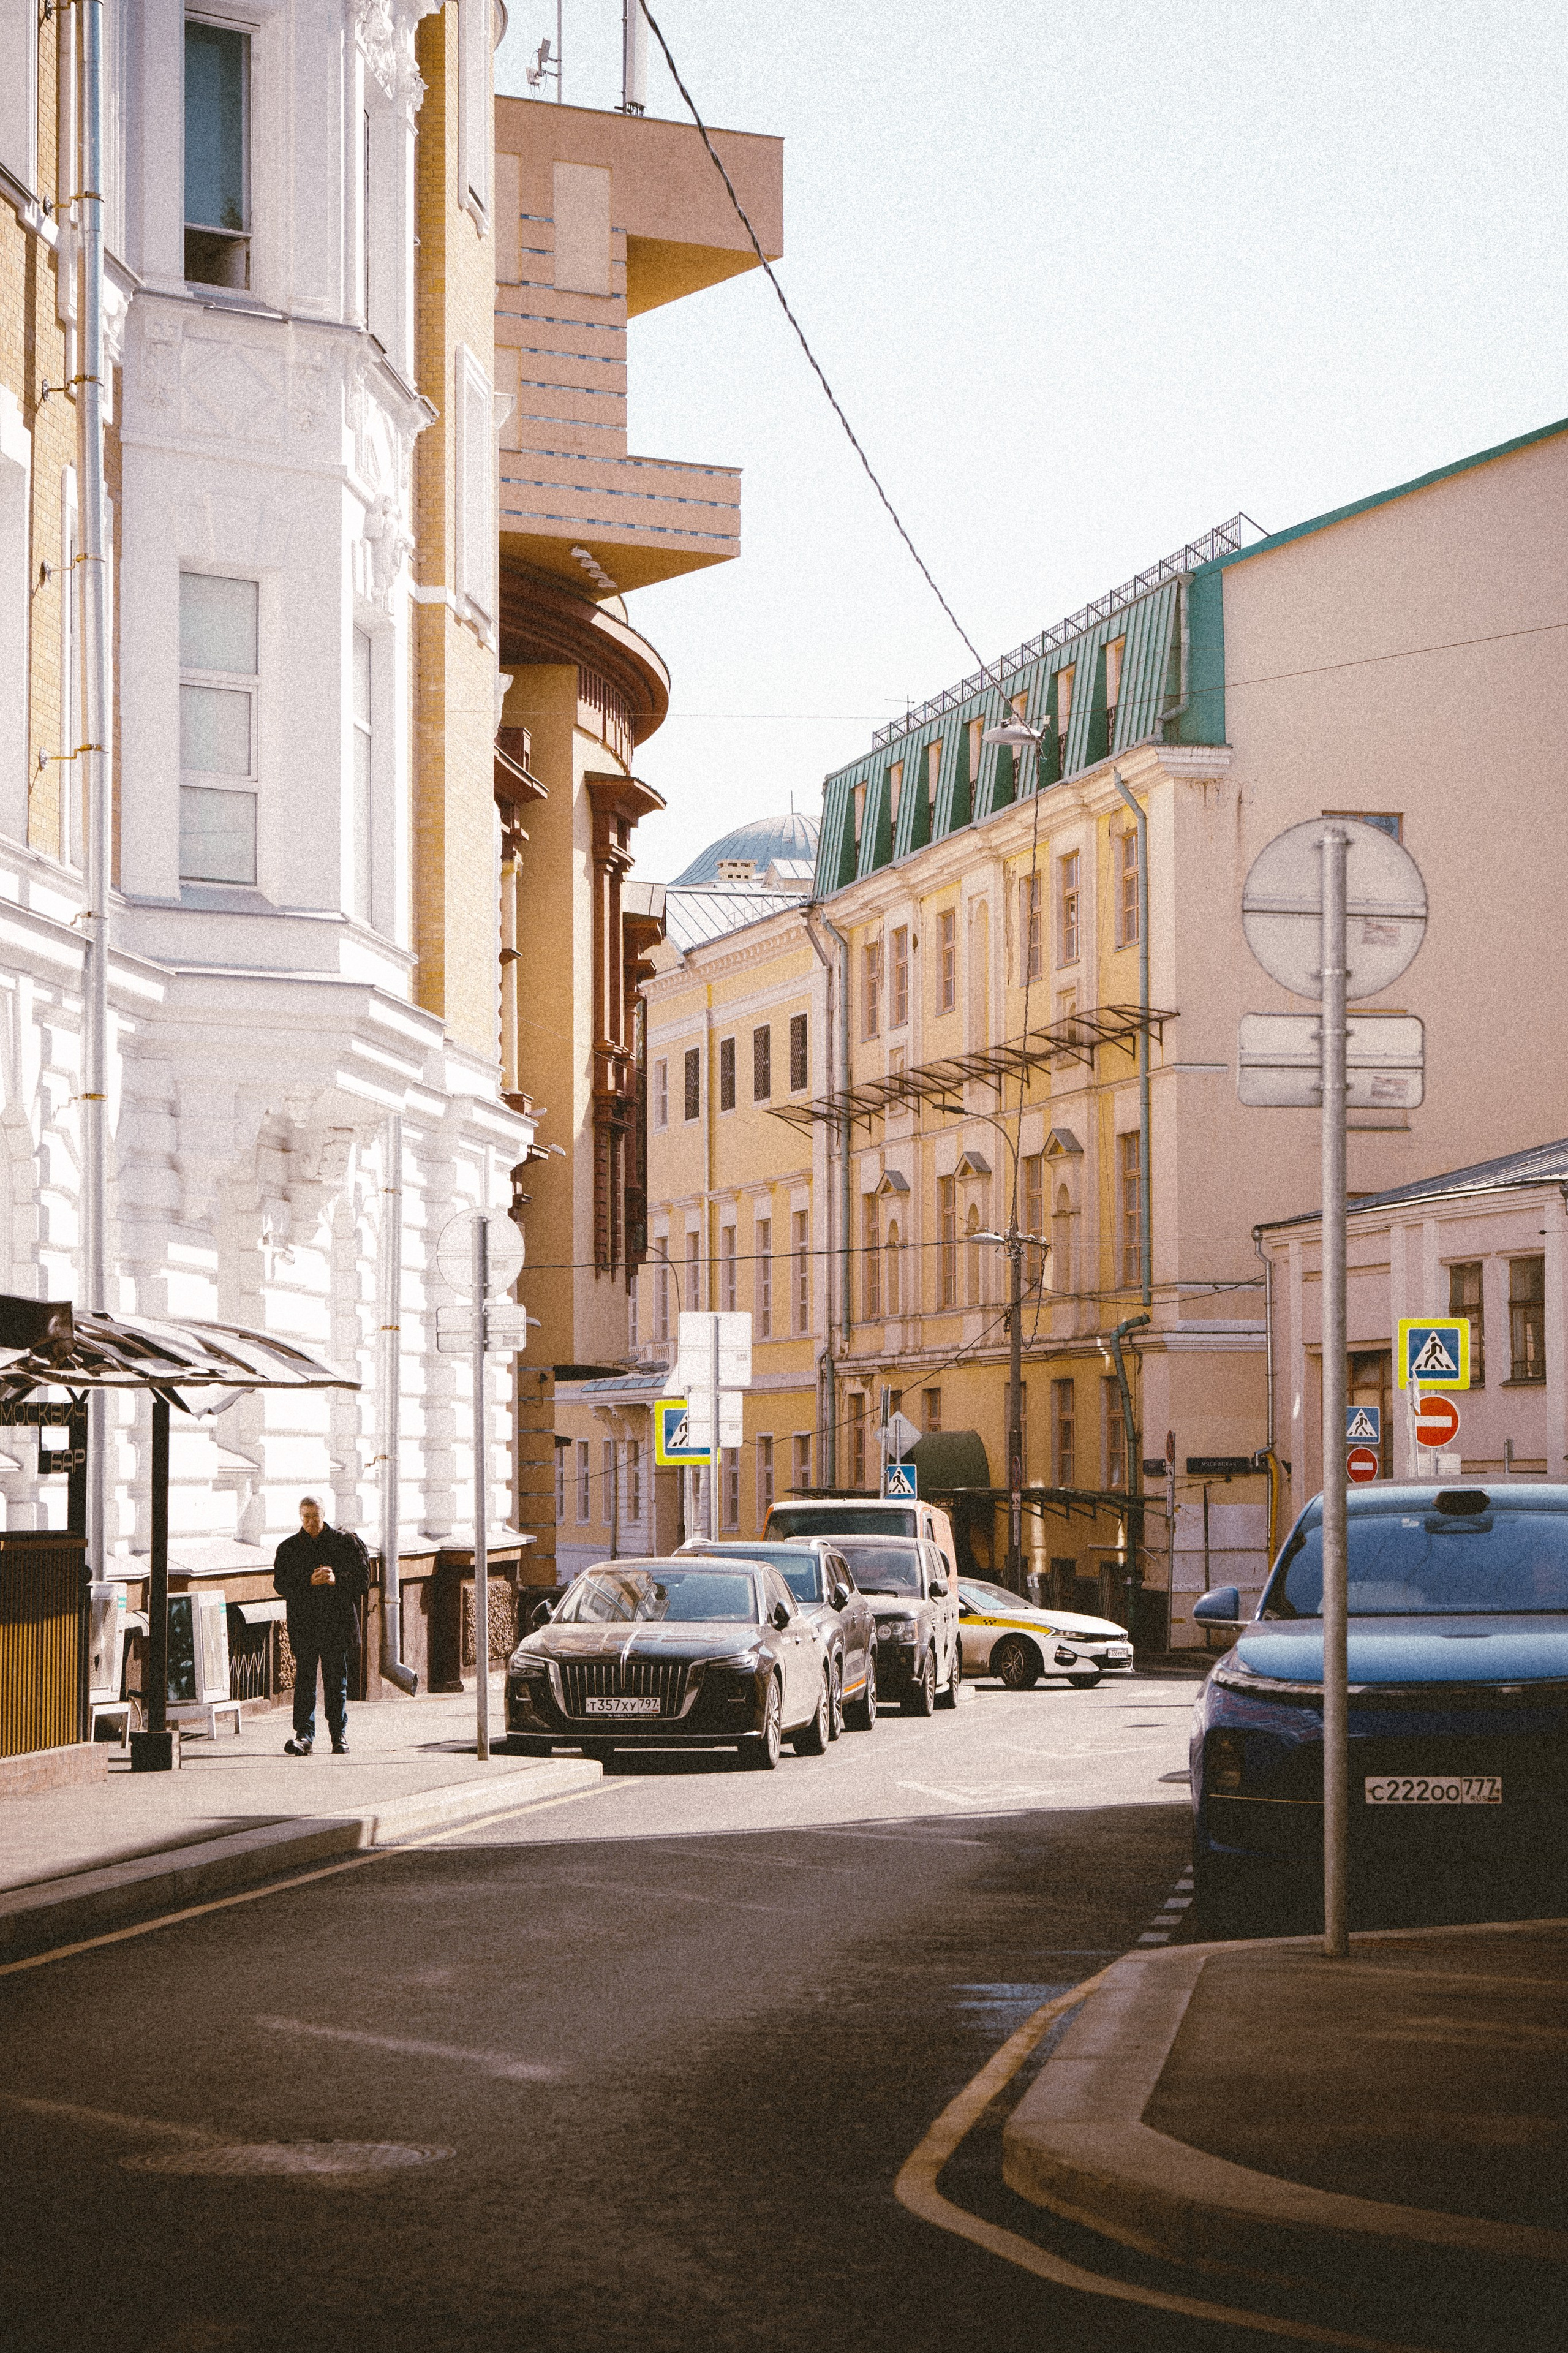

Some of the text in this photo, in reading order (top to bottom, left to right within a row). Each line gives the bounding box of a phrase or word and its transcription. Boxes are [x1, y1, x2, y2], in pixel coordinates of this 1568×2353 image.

[1, 1402, 86, 1426] МОСКВИЧ
[51, 1448, 85, 1473] БАР
[590, 1699, 657, 1711] Т357ХУ 797
[1371, 1778, 1496, 1801] С222ОО 777
